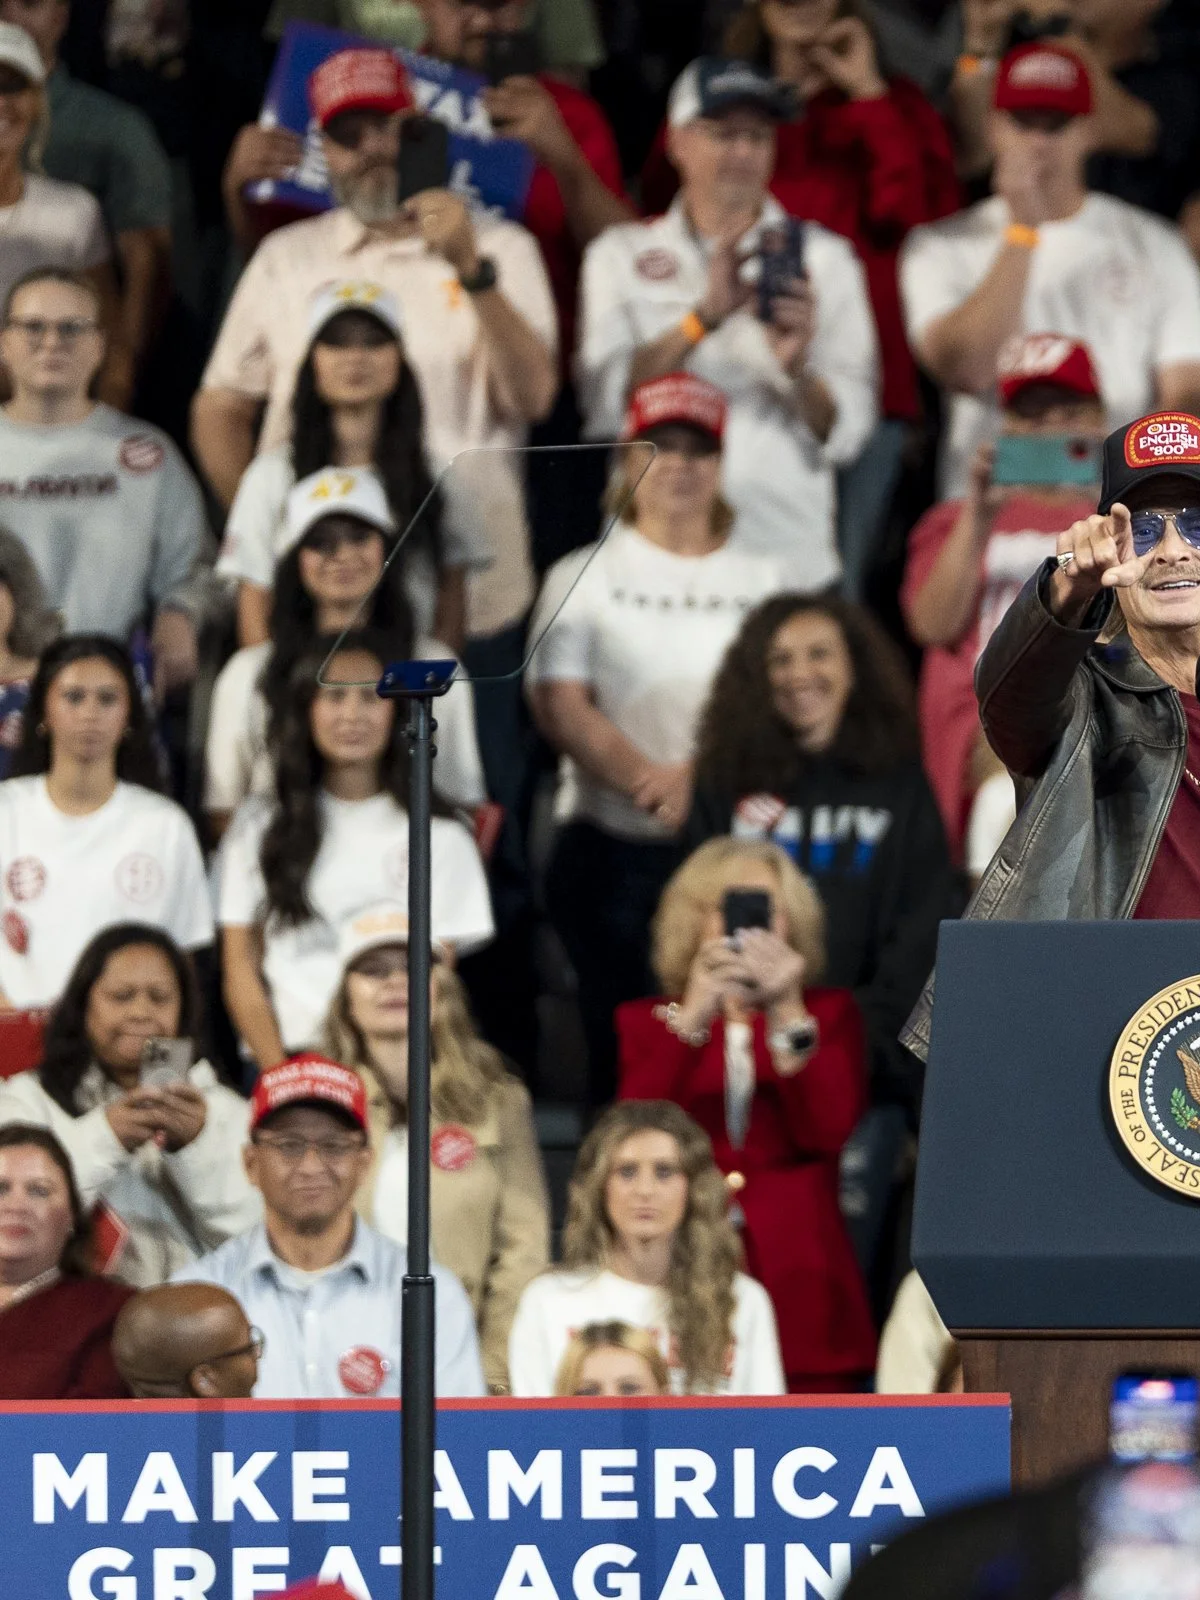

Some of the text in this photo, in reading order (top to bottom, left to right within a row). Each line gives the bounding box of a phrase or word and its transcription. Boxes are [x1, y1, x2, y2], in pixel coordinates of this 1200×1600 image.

[1139, 433, 1198, 449] ENGLISH
[1147, 423, 1189, 435] OLDE
[1121, 1088, 1137, 1120] THE
[1129, 1122, 1147, 1143] OF
[33, 1446, 926, 1523] MAKE AMERICA
[493, 1542, 890, 1600] AGAIN
